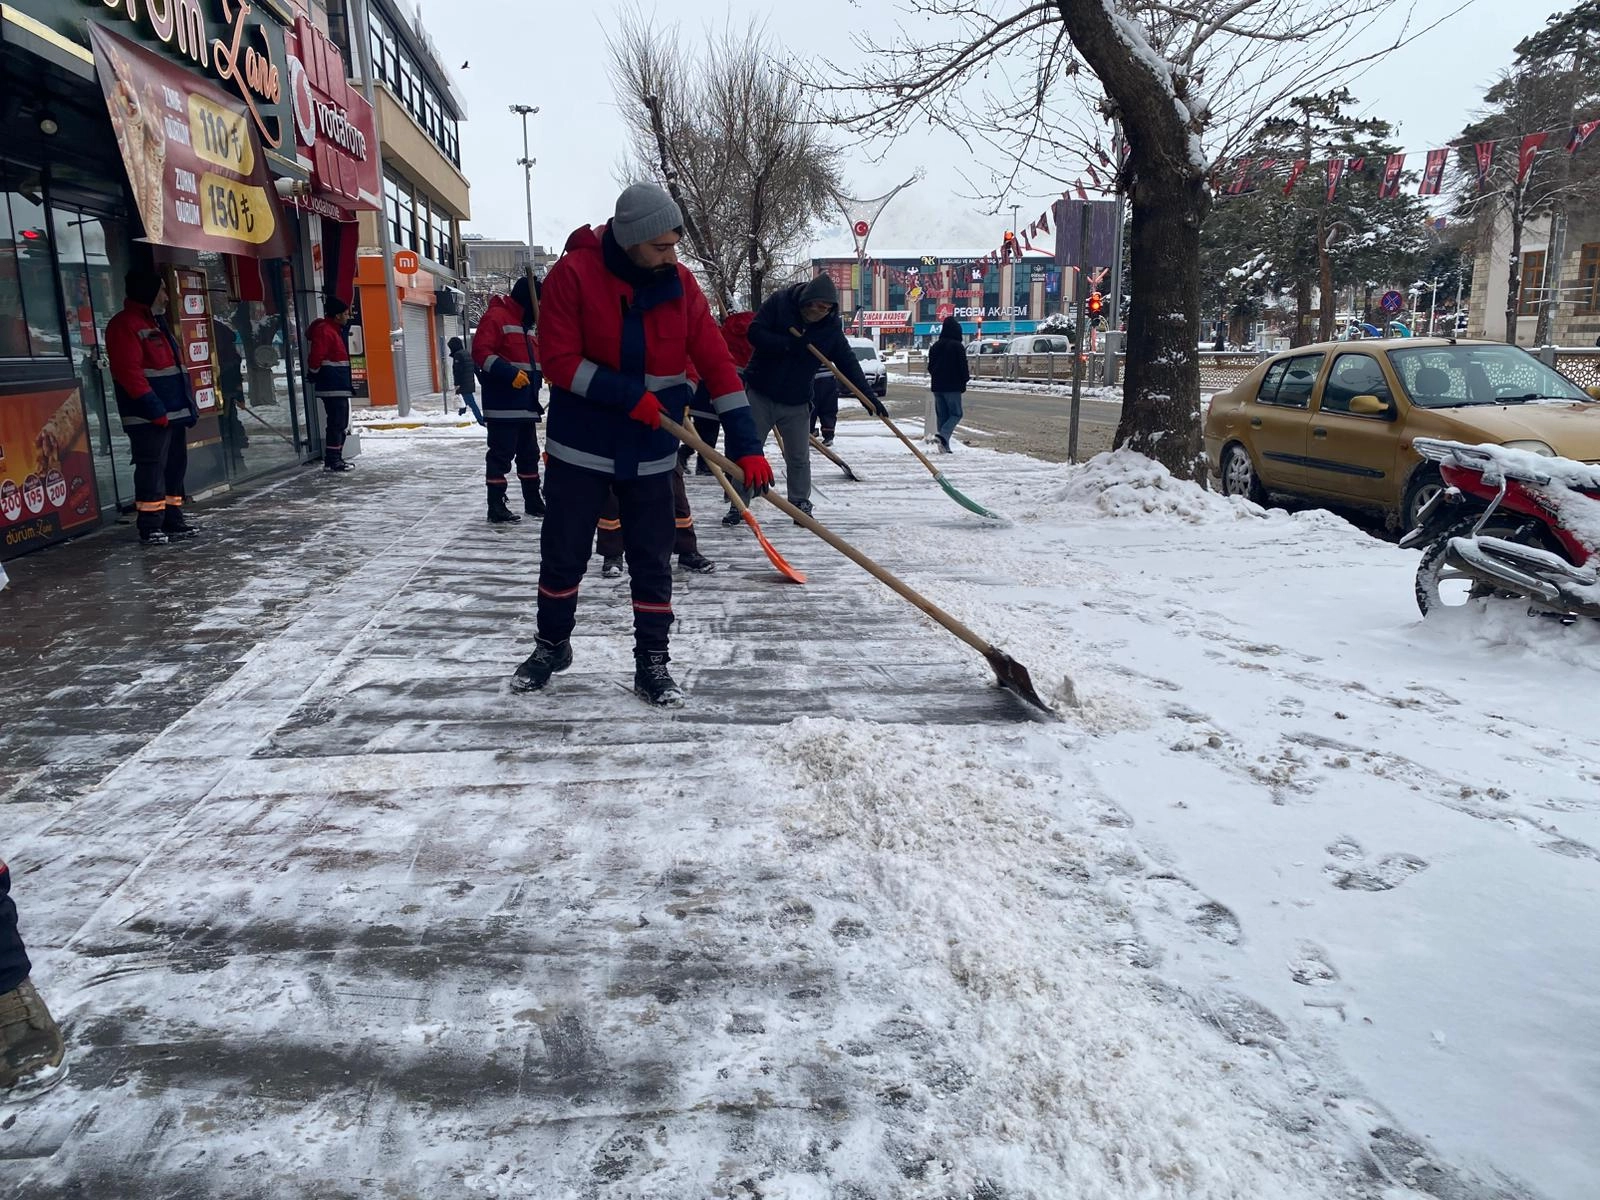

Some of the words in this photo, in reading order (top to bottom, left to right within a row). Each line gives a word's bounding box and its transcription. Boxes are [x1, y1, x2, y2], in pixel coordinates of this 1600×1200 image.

[316, 100, 367, 162] vodafone
[954, 307, 985, 317] PEGEM
[26, 489, 43, 507] 195
[49, 483, 65, 501] 200
[2, 491, 21, 514] 200
